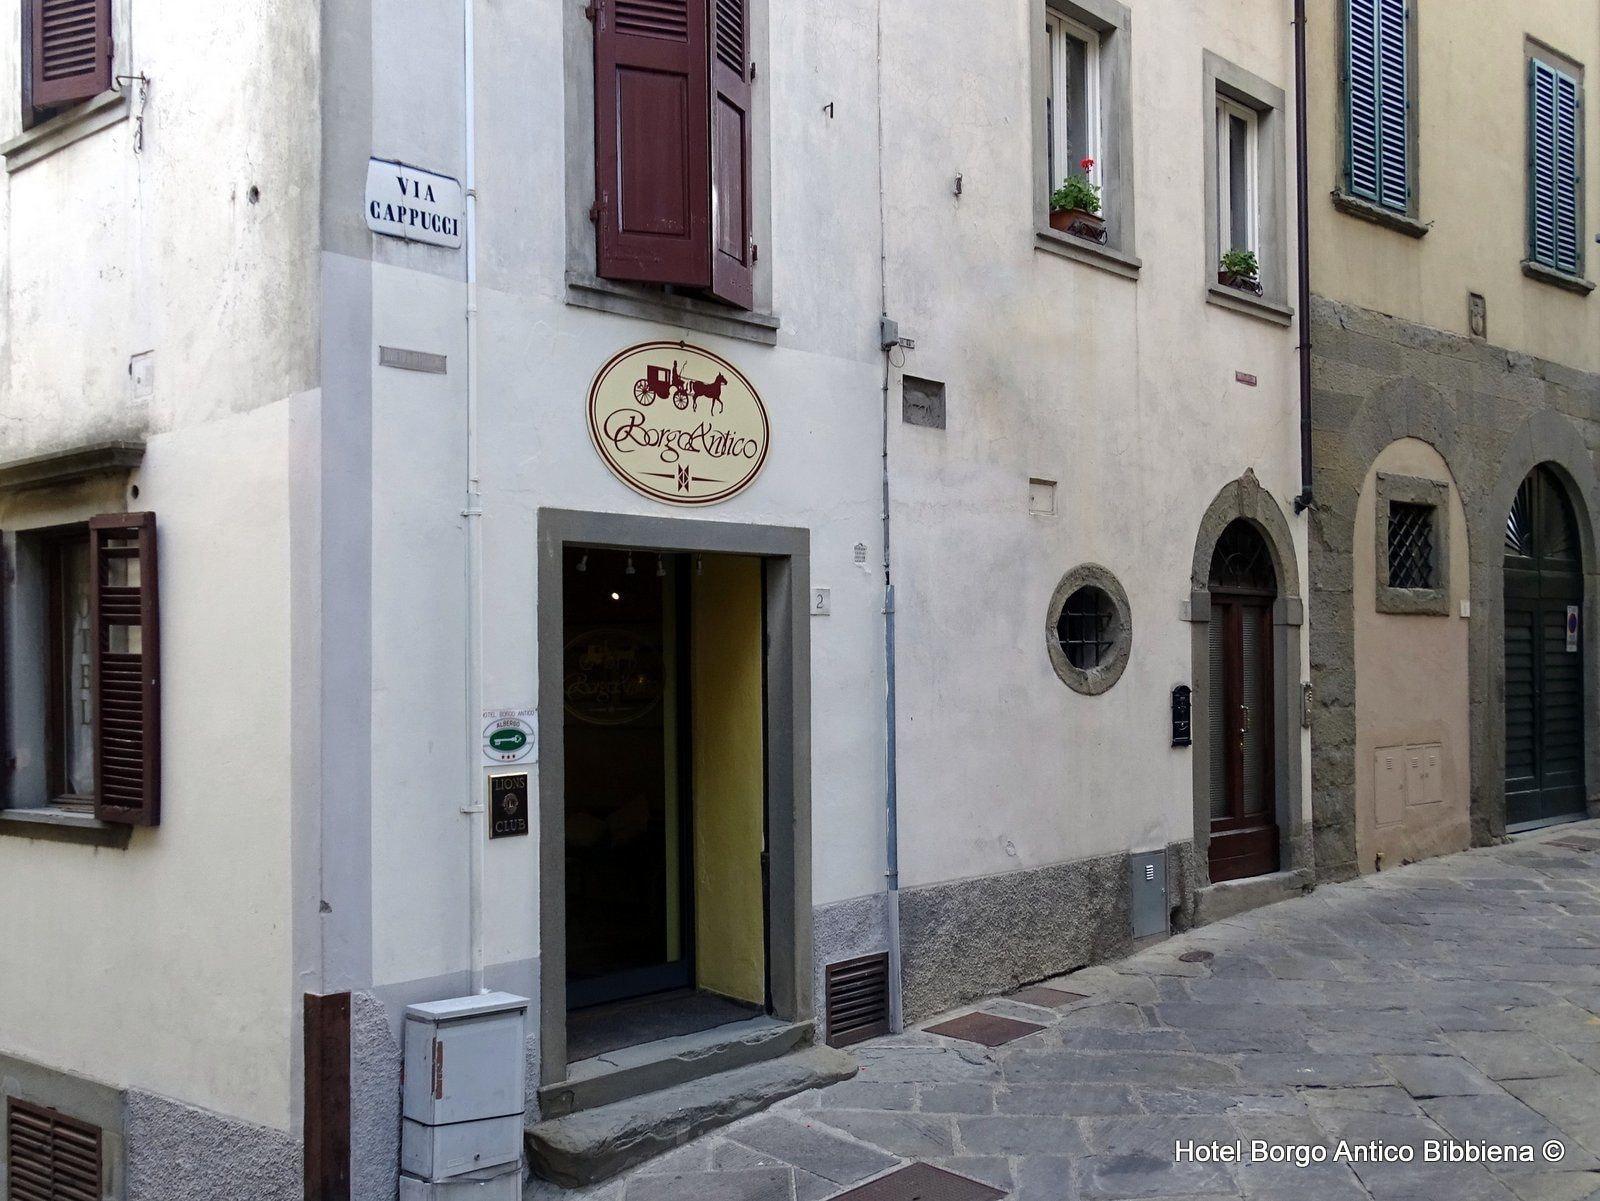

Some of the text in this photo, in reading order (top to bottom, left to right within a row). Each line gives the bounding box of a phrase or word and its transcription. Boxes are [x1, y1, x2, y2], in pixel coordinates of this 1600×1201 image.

[396, 176, 436, 203] VIA
[370, 200, 458, 237] CAPPUCCI
[816, 593, 825, 609] 2
[495, 777, 525, 791] LIONS
[495, 818, 526, 833] CLUB
